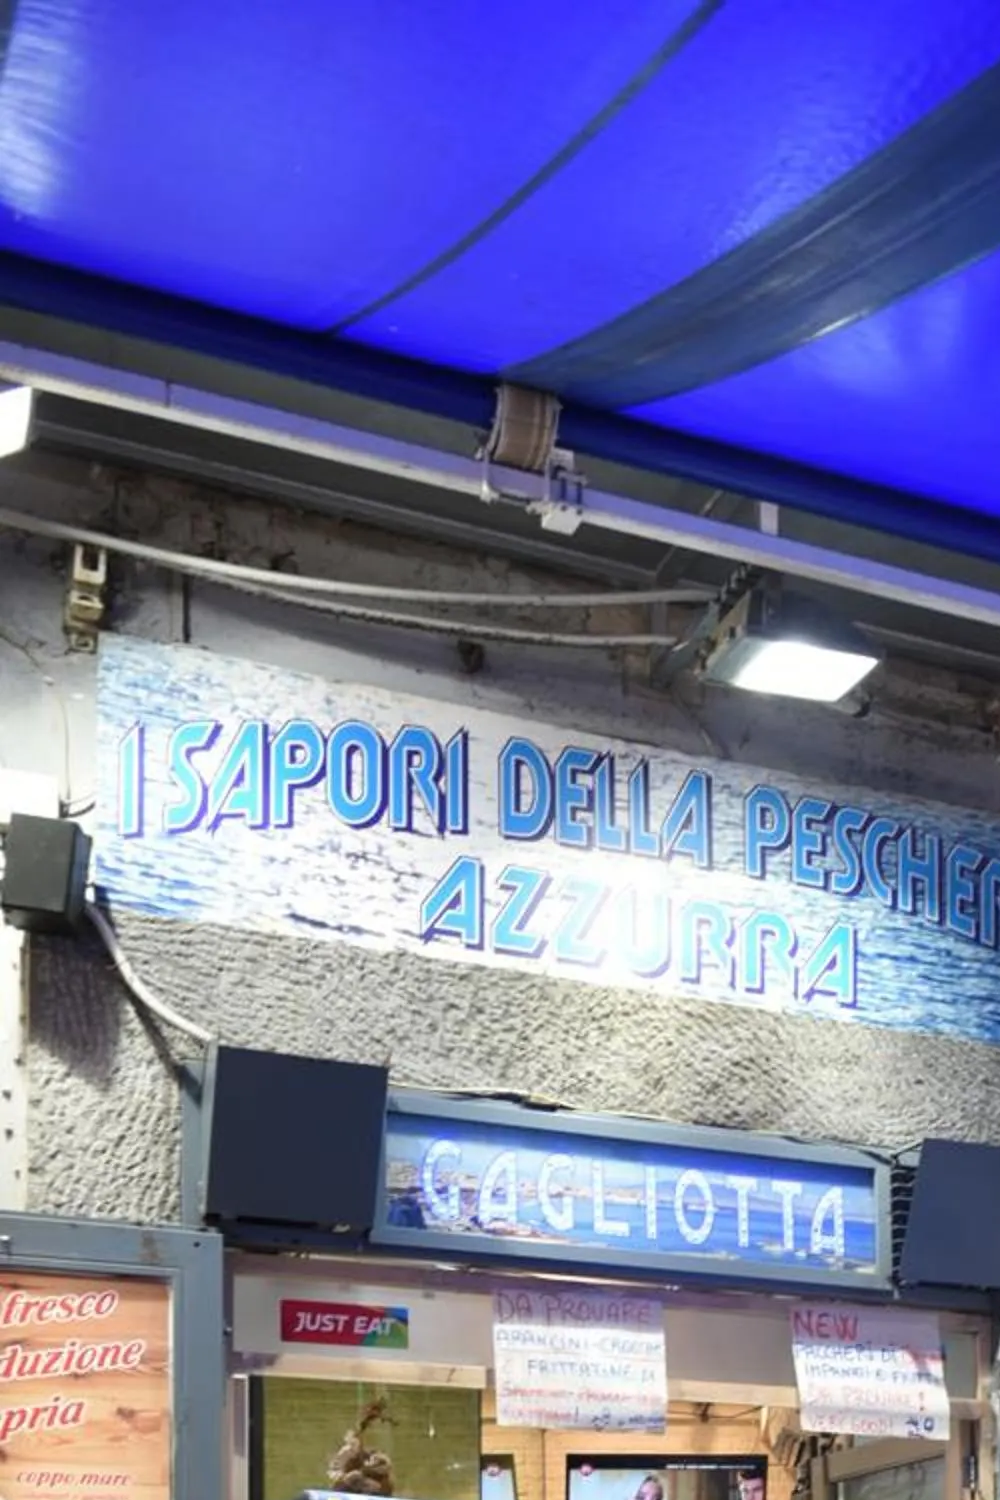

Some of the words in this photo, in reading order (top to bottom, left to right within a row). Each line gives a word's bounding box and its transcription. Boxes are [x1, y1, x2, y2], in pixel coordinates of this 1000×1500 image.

[118, 719, 144, 838] I
[163, 718, 468, 840] SAPORI
[498, 735, 712, 871] DELLA
[420, 855, 858, 1008] AZZURRA
[422, 1139, 846, 1257] GAGLIOTTA
[2, 1290, 118, 1325] fresco
[293, 1311, 349, 1333] JUST
[353, 1315, 395, 1337] EAT
[793, 1309, 859, 1341] NEW
[0, 1396, 84, 1440] pria
